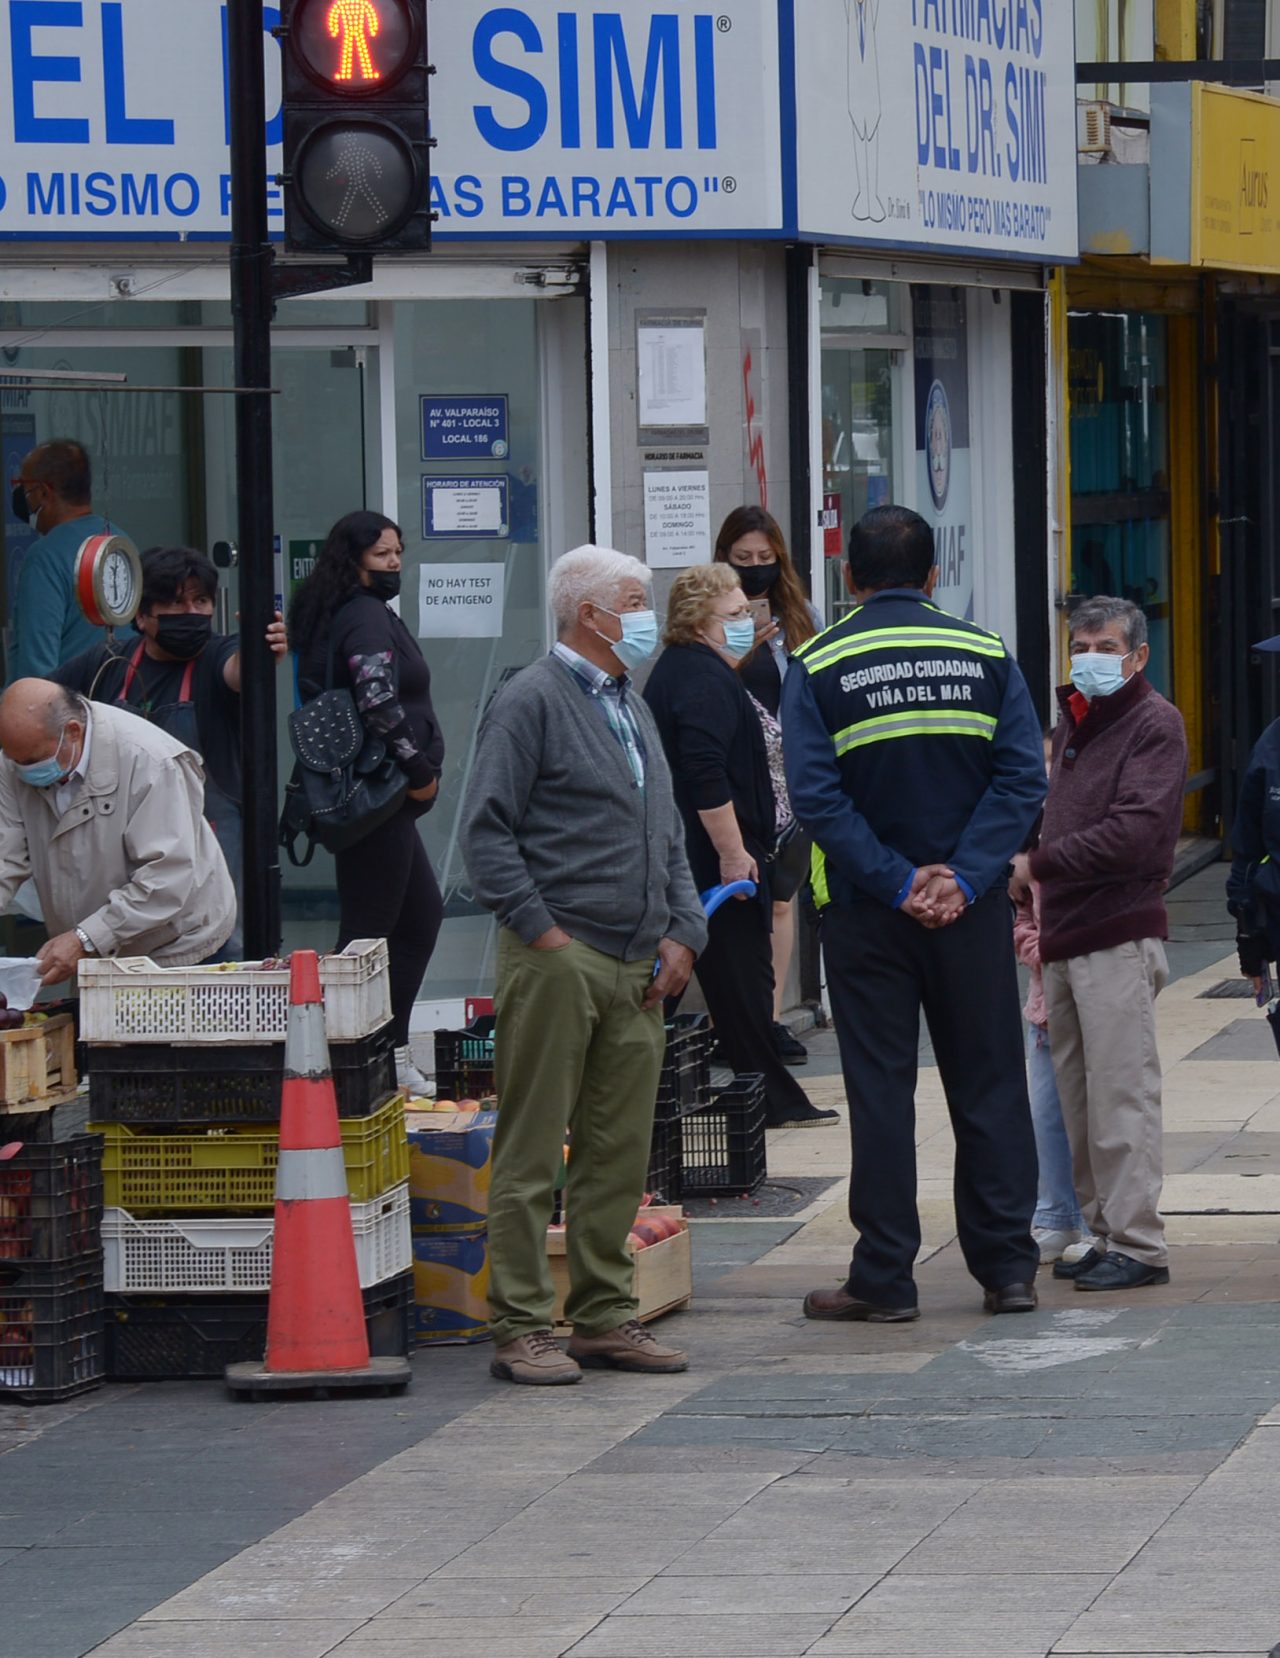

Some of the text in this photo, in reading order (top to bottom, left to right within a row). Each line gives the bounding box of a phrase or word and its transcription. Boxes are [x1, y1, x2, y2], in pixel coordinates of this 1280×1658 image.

[9, 0, 175, 145] EL
[913, 42, 961, 171] DEL
[965, 53, 1002, 178] DR.
[1240, 160, 1268, 209] Aurus
[26, 172, 200, 217] MISMO
[430, 175, 484, 218] AS
[937, 190, 967, 232] MISMO
[968, 196, 992, 235] PERO
[429, 406, 500, 418] AV. VALPARAÍSO
[463, 418, 492, 428] LOCAL
[494, 418, 500, 428] 3
[442, 434, 472, 444] LOCAL
[426, 480, 459, 488] HORARIO
[460, 480, 468, 488] DE
[648, 485, 670, 493] LUNES
[677, 484, 706, 492] VIERNES
[428, 577, 491, 588] NO HAY TEST
[425, 594, 493, 606] DE ANTIGENO
[840, 660, 985, 693] SEGURIDAD CIUDADANA
[866, 684, 972, 709] VIÑA DEL MAR
